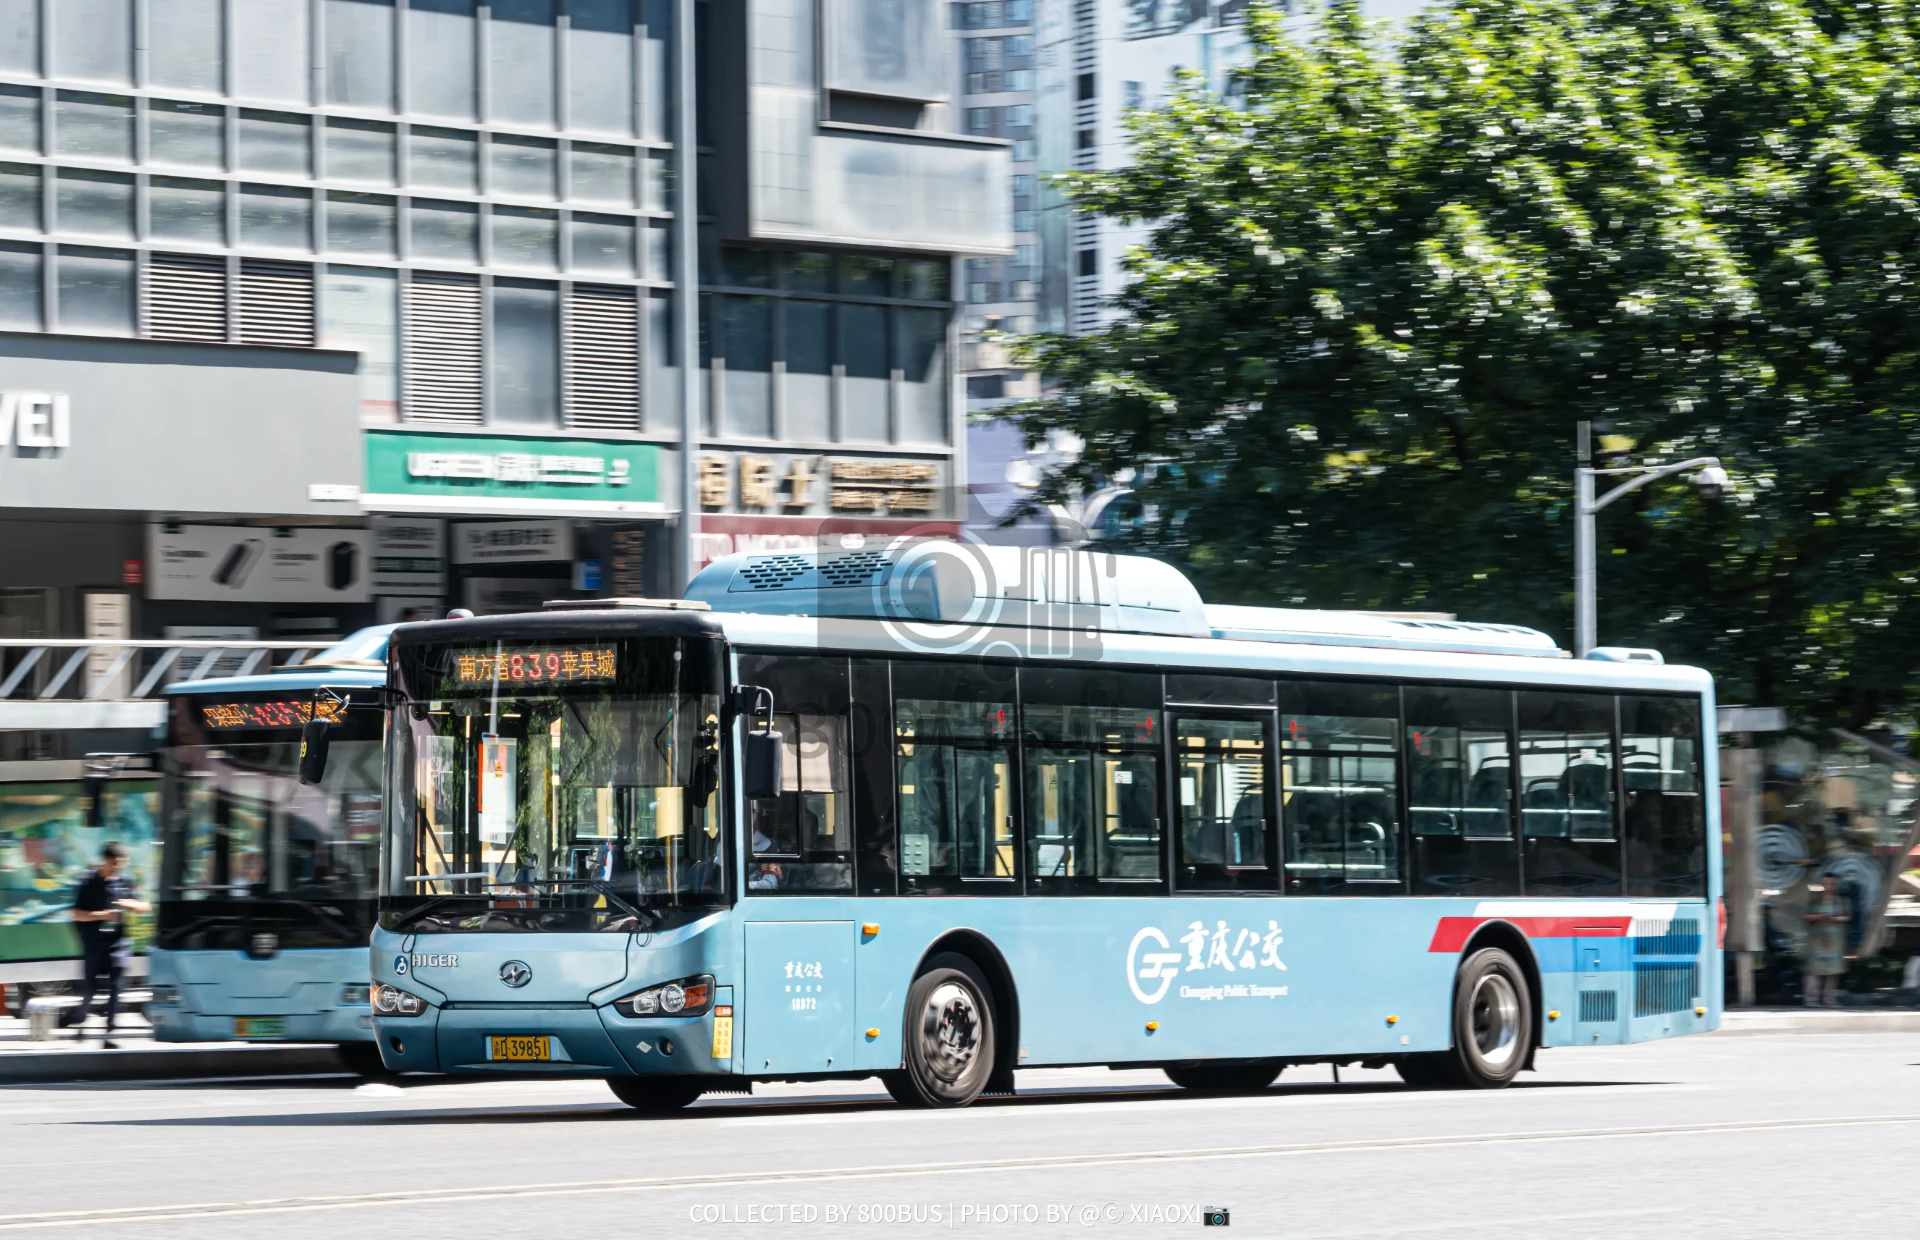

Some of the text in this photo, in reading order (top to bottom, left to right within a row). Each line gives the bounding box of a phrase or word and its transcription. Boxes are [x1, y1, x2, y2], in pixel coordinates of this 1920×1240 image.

[0, 393, 71, 447] EI
[411, 954, 459, 968] HIGER
[1179, 920, 1288, 971] 重庆公交
